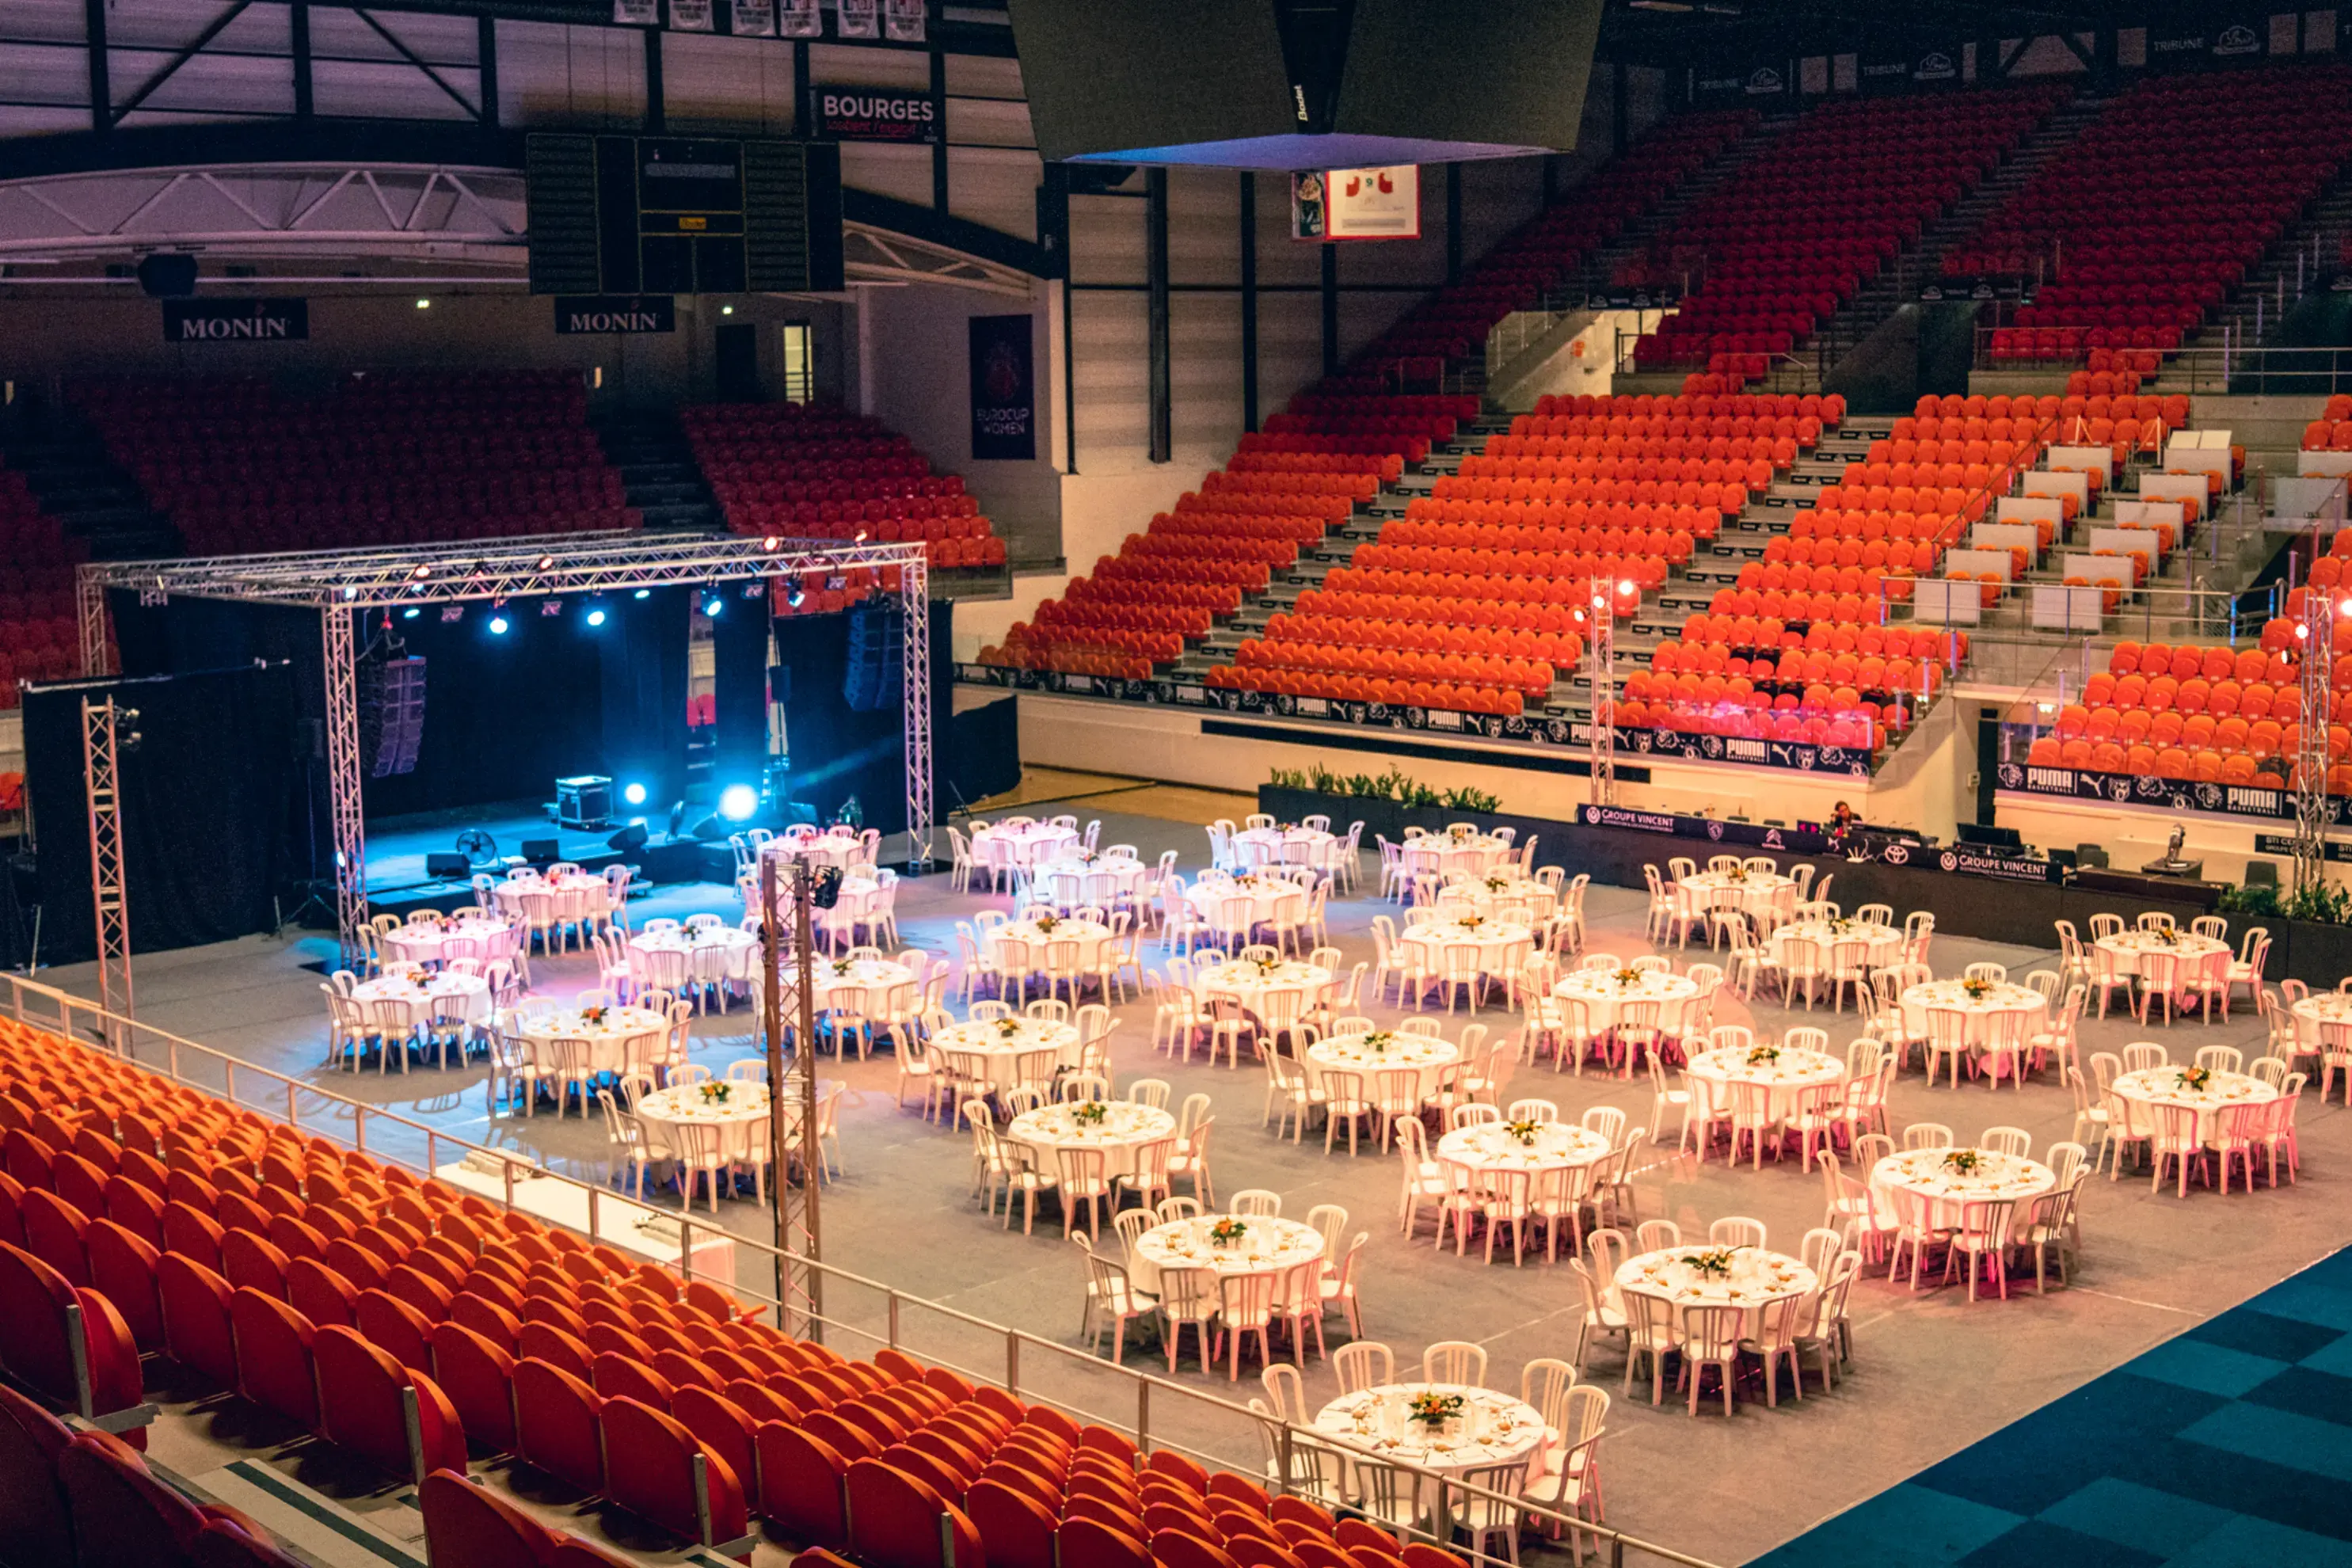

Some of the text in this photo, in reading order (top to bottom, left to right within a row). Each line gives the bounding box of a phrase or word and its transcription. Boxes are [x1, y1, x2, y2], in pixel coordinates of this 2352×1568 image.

[2154, 37, 2204, 51] TRIBUNE
[824, 95, 934, 121] BOURGES
[1293, 84, 1308, 122] Bodet
[1365, 177, 1373, 187] 9
[182, 318, 286, 339] MONIN
[570, 313, 657, 331] MONIN
[977, 408, 1029, 421] EUROCUP
[981, 421, 1025, 435] WOMEN
[1428, 710, 1460, 726] PUMA
[1726, 739, 1765, 757] PUMA
[2027, 767, 2072, 788] PUMA
[2228, 787, 2277, 809] PUMA
[1601, 809, 1673, 827] GROUPE VINCENT
[1958, 855, 2047, 875] GROUPE VINCENT
